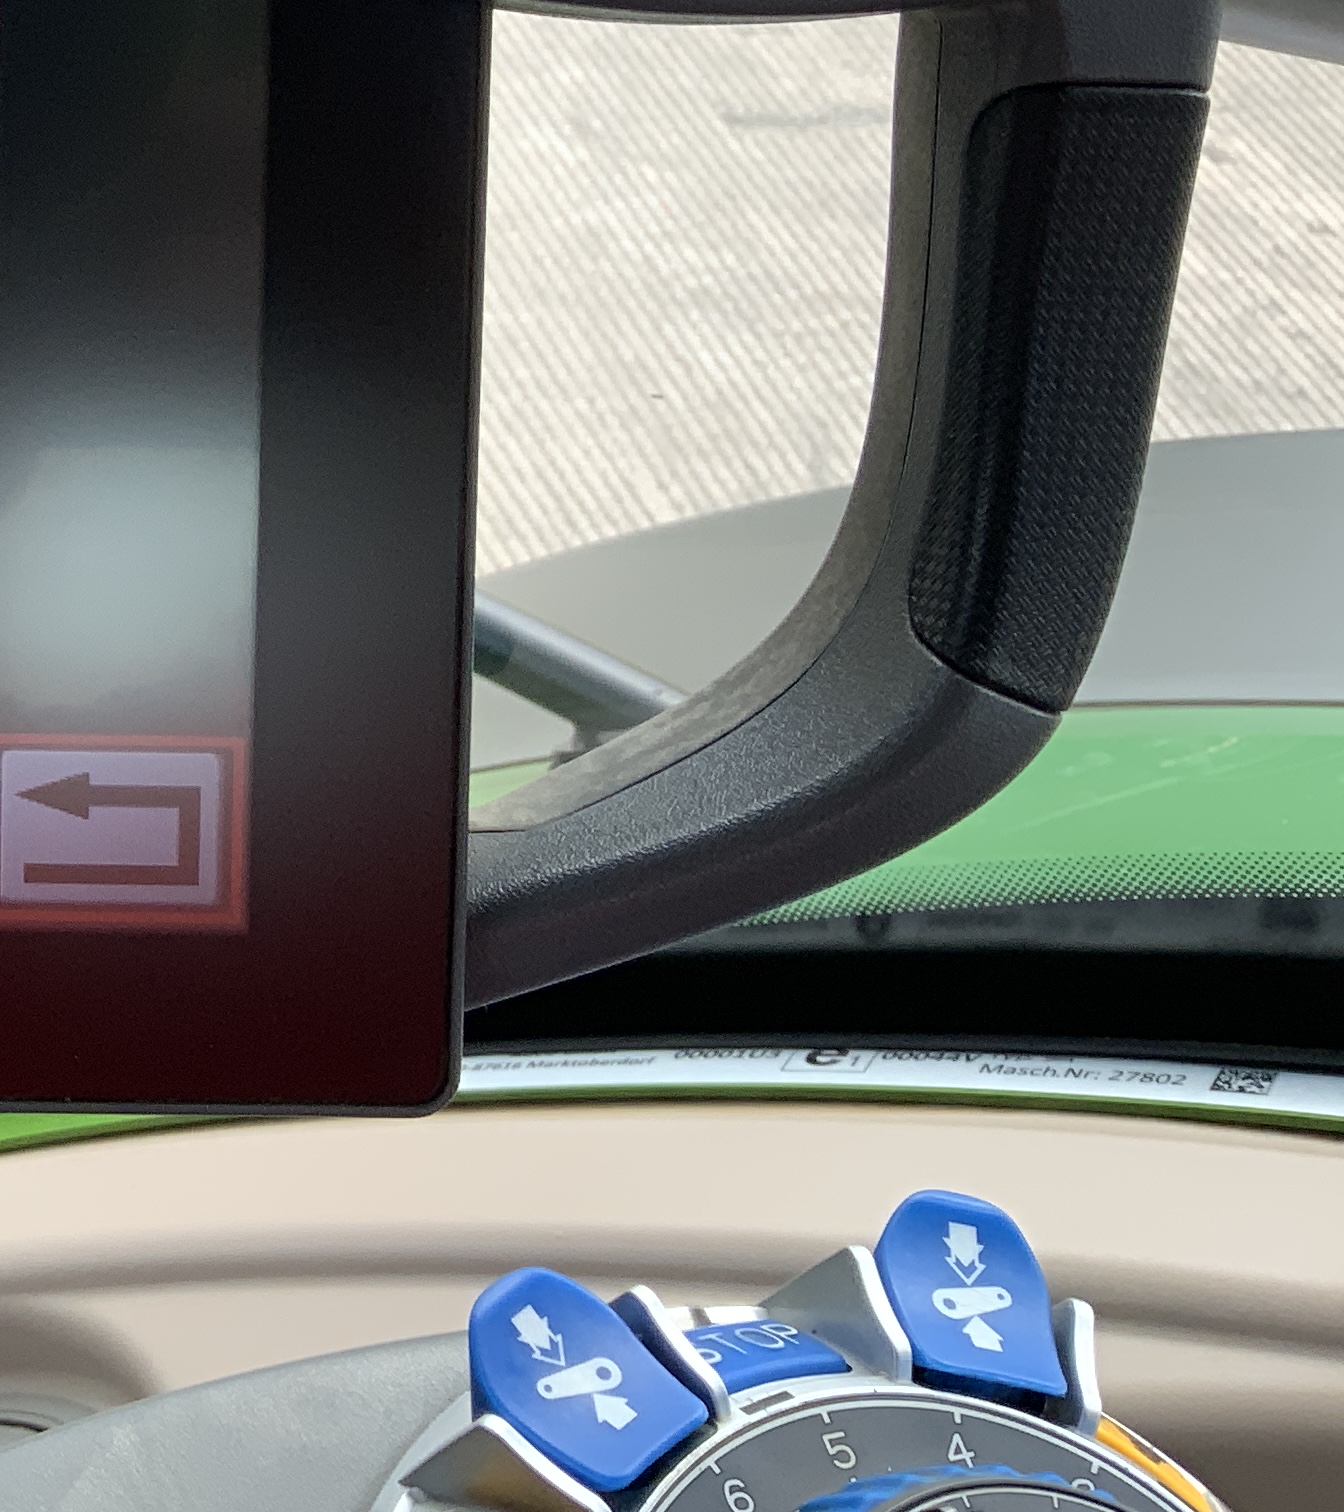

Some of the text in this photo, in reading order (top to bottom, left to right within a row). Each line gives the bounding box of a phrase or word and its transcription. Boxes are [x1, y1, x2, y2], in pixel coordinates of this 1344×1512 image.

[1108, 1070, 1188, 1086] 27802
[822, 1431, 857, 1470] 5
[946, 1432, 976, 1468] 4
[722, 1478, 756, 1512] 6
